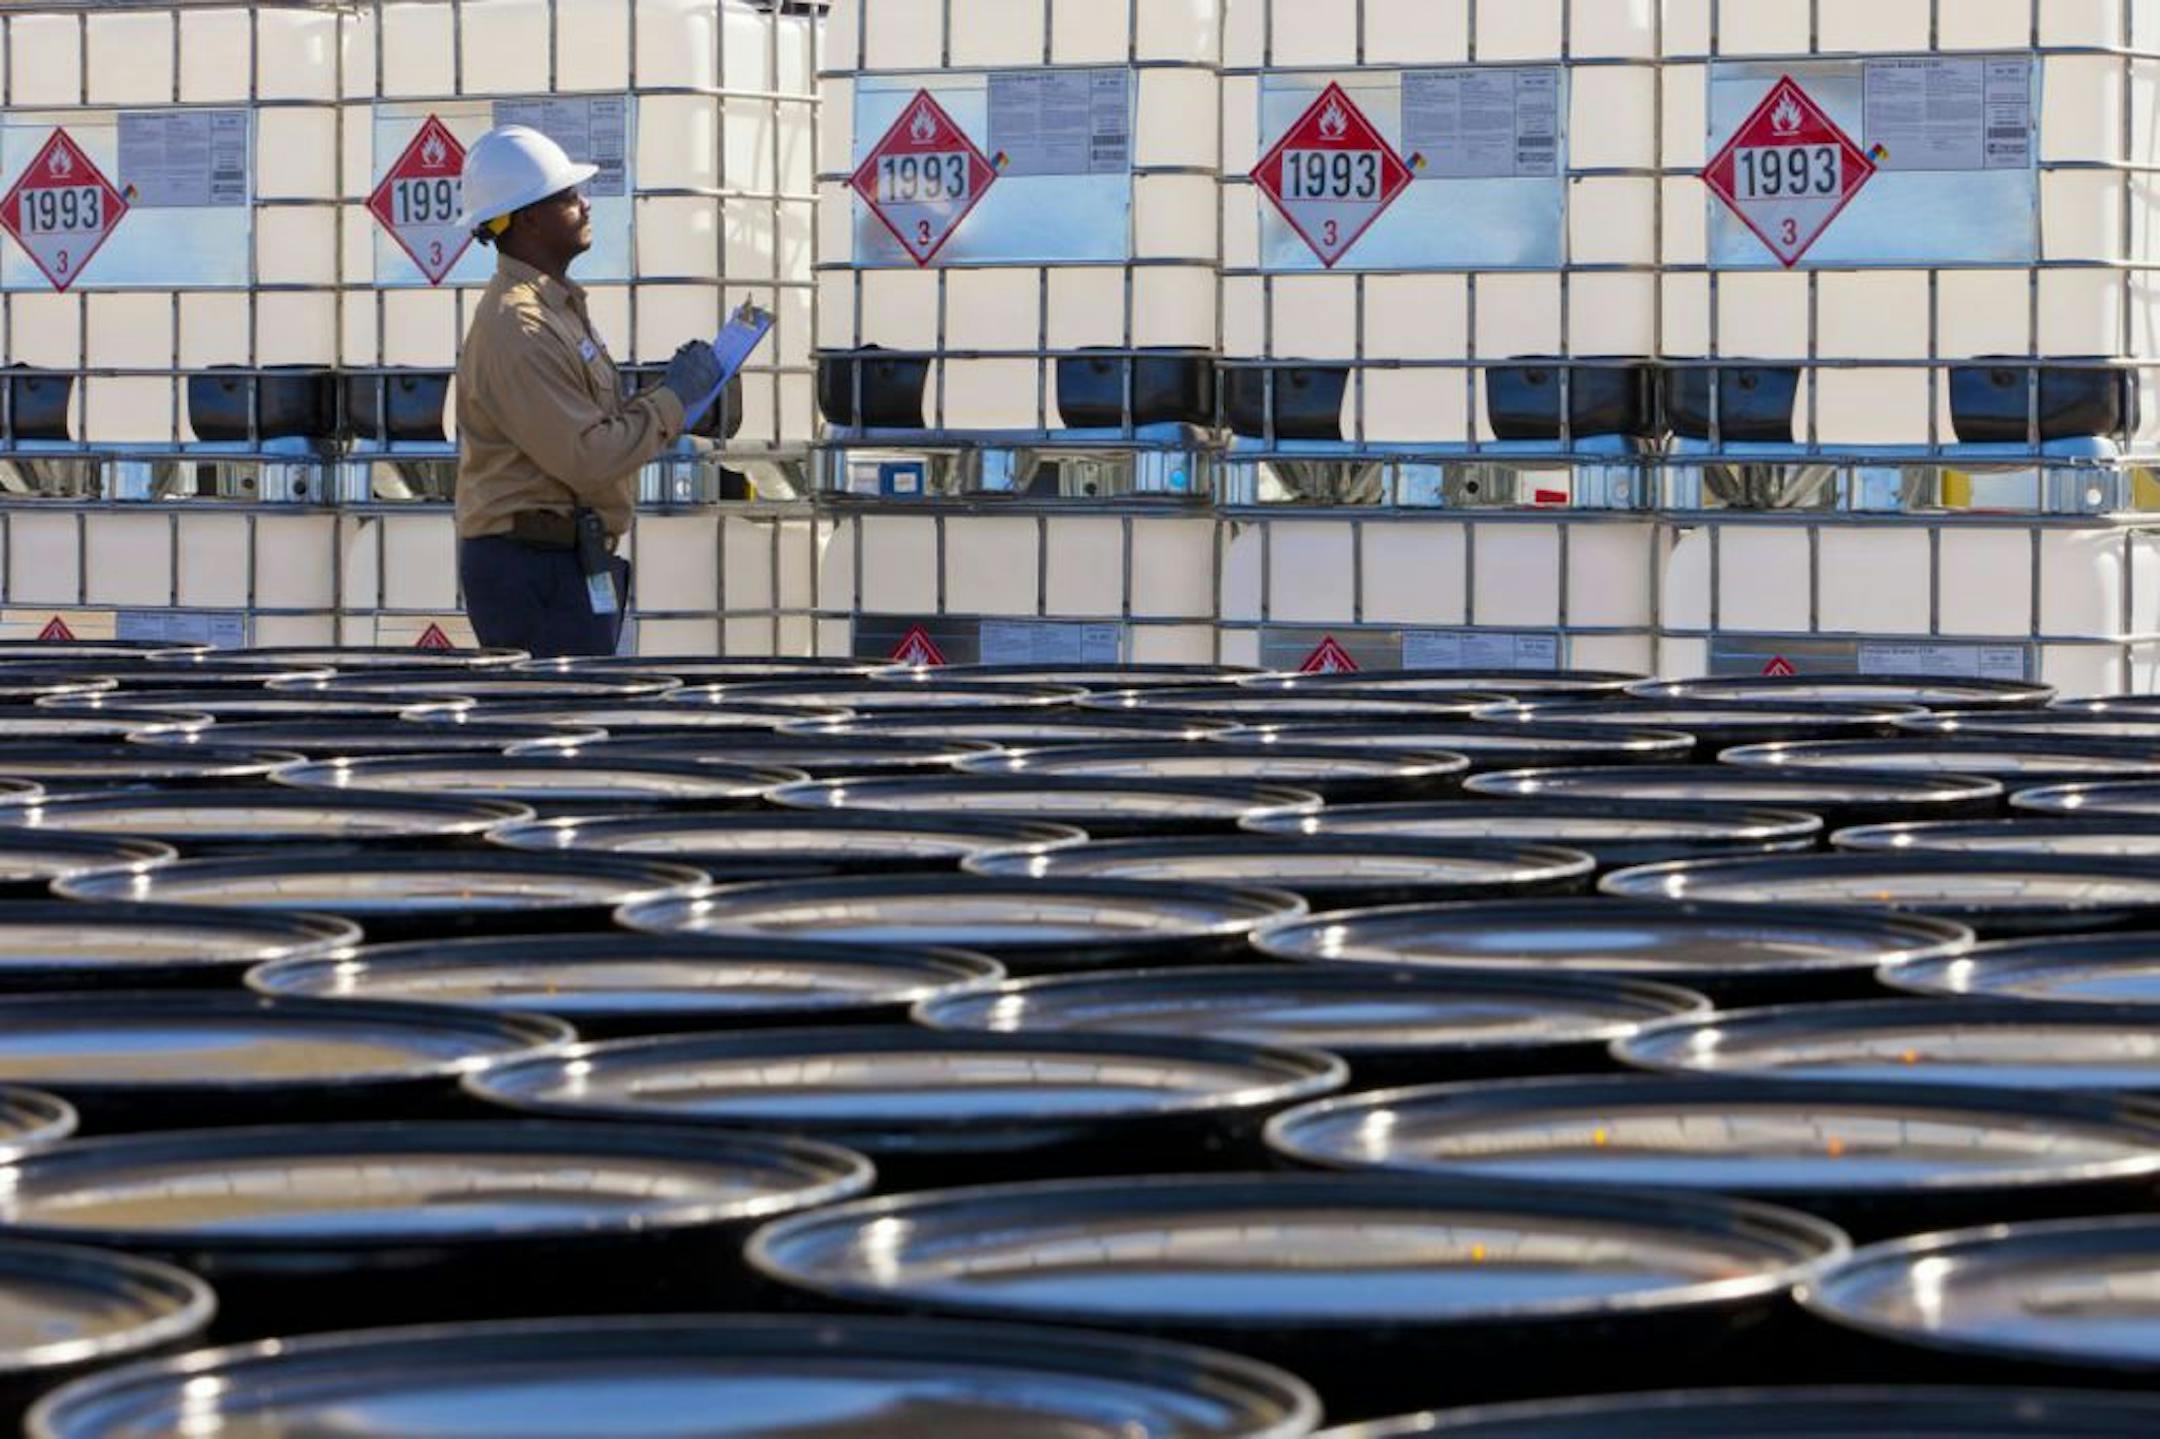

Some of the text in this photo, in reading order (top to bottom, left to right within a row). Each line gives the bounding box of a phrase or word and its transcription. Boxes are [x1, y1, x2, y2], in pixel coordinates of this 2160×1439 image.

[883, 154, 964, 201] 1993
[1289, 152, 1376, 198] 1993
[1741, 147, 1836, 197] 1993
[25, 188, 99, 230] 1993
[917, 219, 931, 246] 3
[1322, 219, 1337, 246] 3
[1781, 218, 1798, 246] 3
[56, 250, 69, 274] 3
[429, 241, 443, 266] 3
